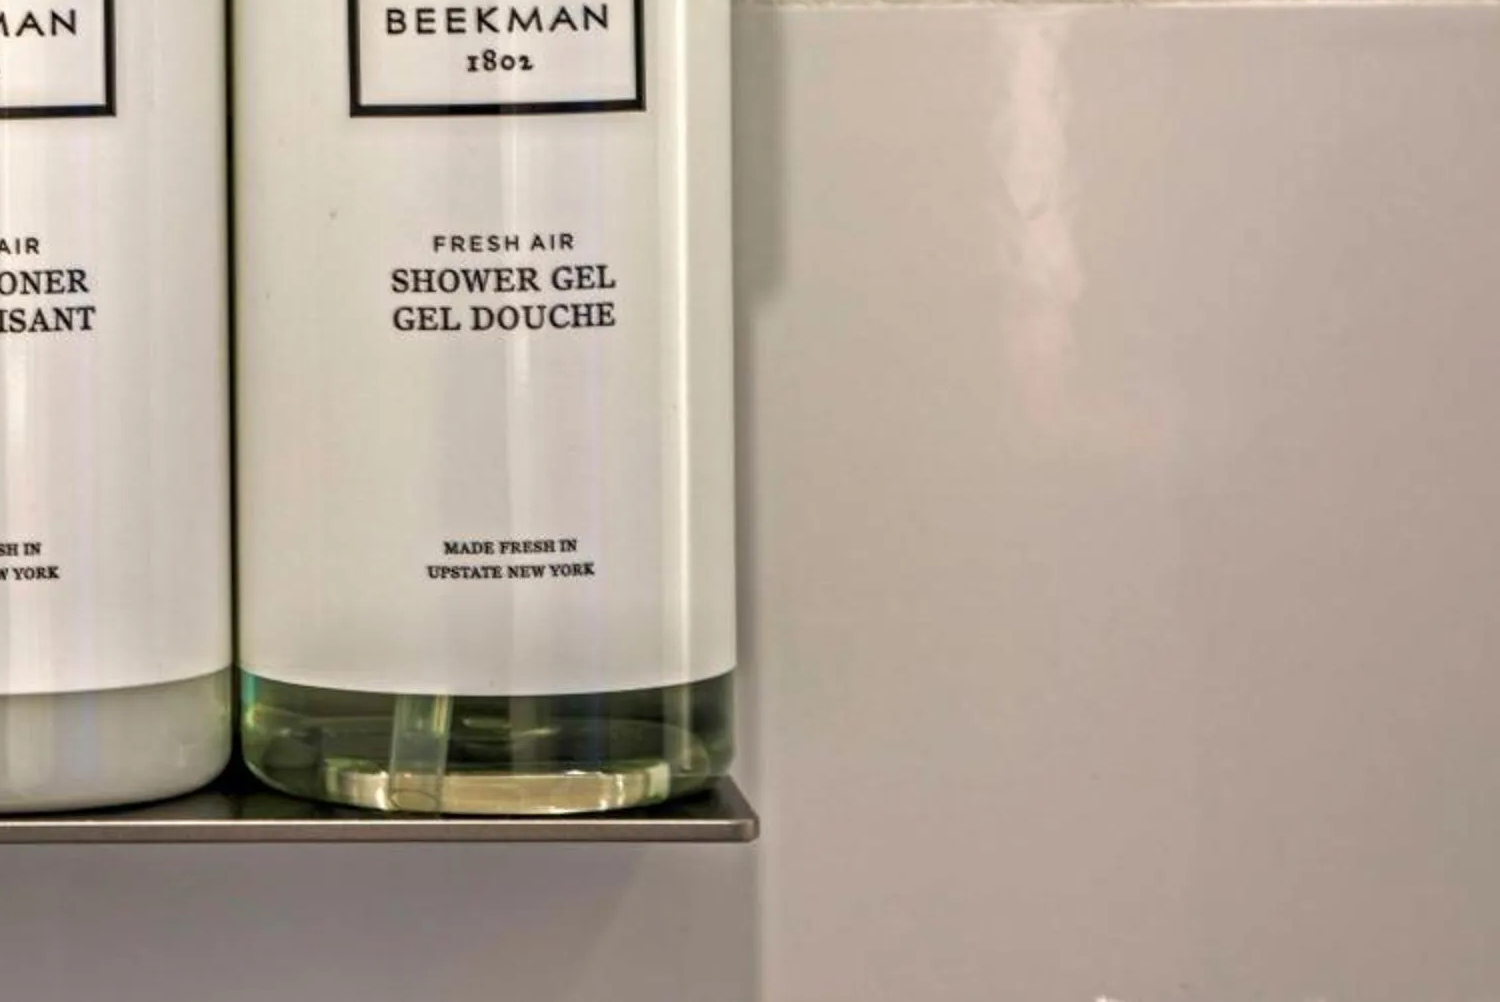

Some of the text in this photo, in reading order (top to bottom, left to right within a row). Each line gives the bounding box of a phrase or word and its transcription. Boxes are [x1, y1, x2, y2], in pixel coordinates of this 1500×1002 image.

[385, 2, 609, 36] BEEKMAN
[466, 48, 535, 73] 1802
[432, 232, 575, 254] FRESH AIR
[390, 263, 617, 294] SHOWER GEL
[392, 301, 616, 332] GEL DOUCHE
[22, 541, 42, 557] IN
[443, 538, 578, 555] MADE FRESH IN
[11, 565, 61, 583] YORK
[426, 561, 596, 579] UPSTATE NEW YORK
